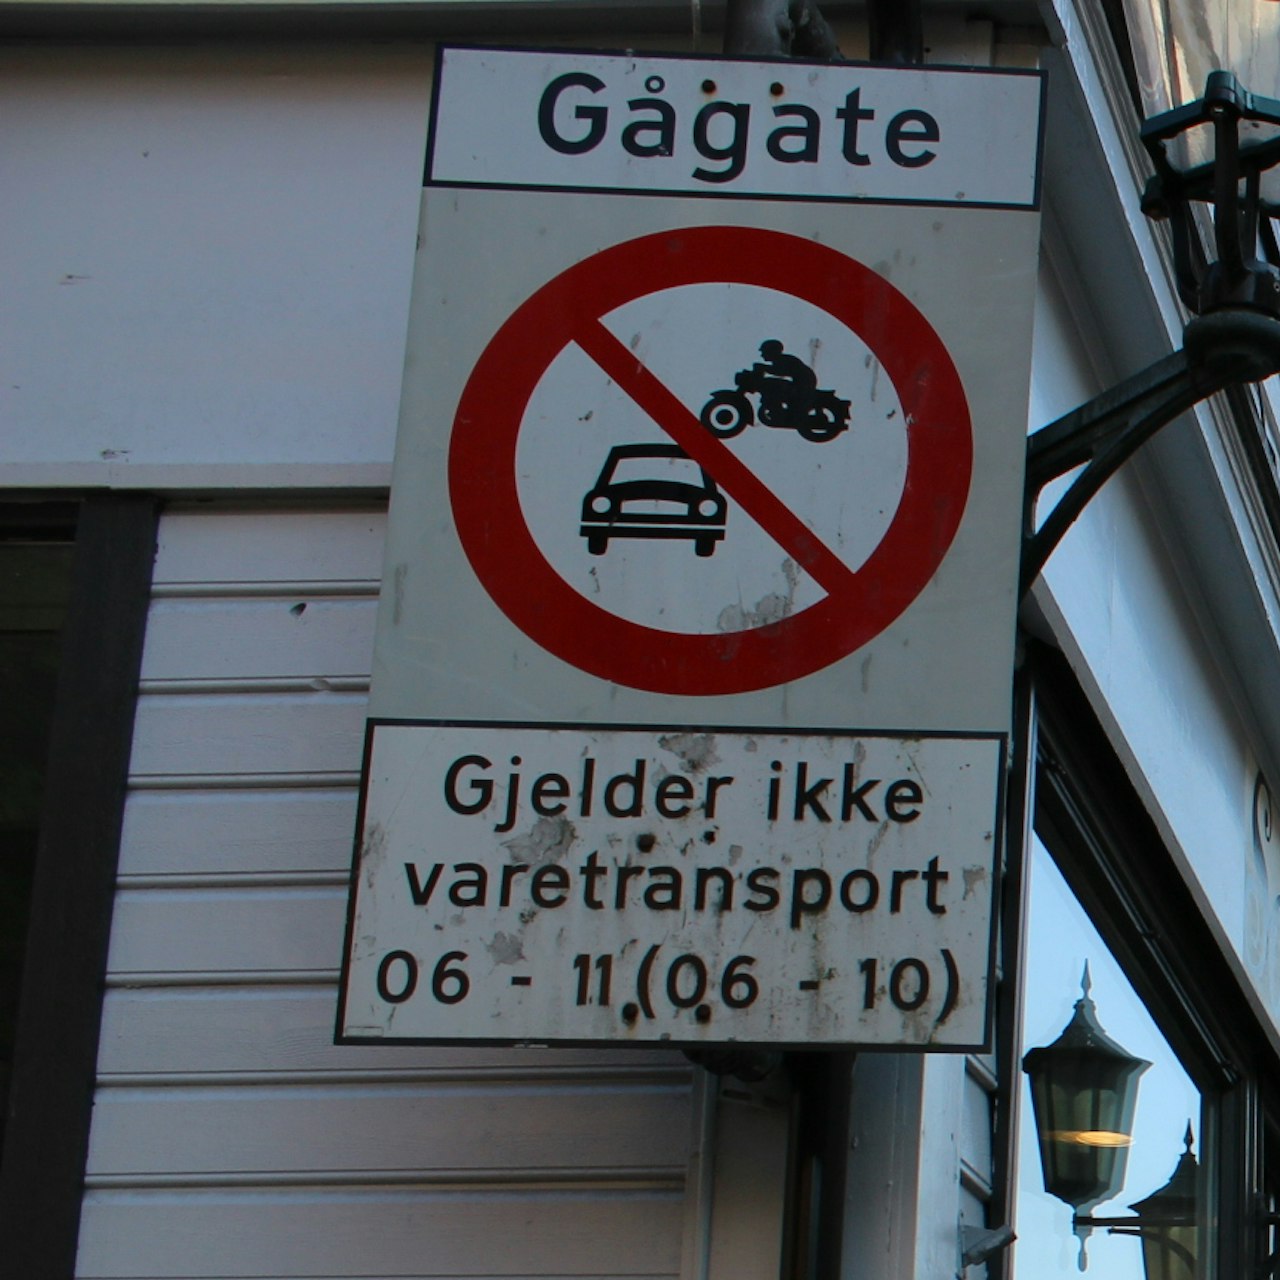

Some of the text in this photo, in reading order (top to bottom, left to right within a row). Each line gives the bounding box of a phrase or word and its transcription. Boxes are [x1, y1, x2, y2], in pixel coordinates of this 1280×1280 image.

[536, 72, 941, 184] Gågate
[443, 754, 925, 833] Gjelder ikke
[403, 850, 950, 931] varetransport
[376, 949, 471, 1005] 06
[858, 948, 961, 1023] 10)
